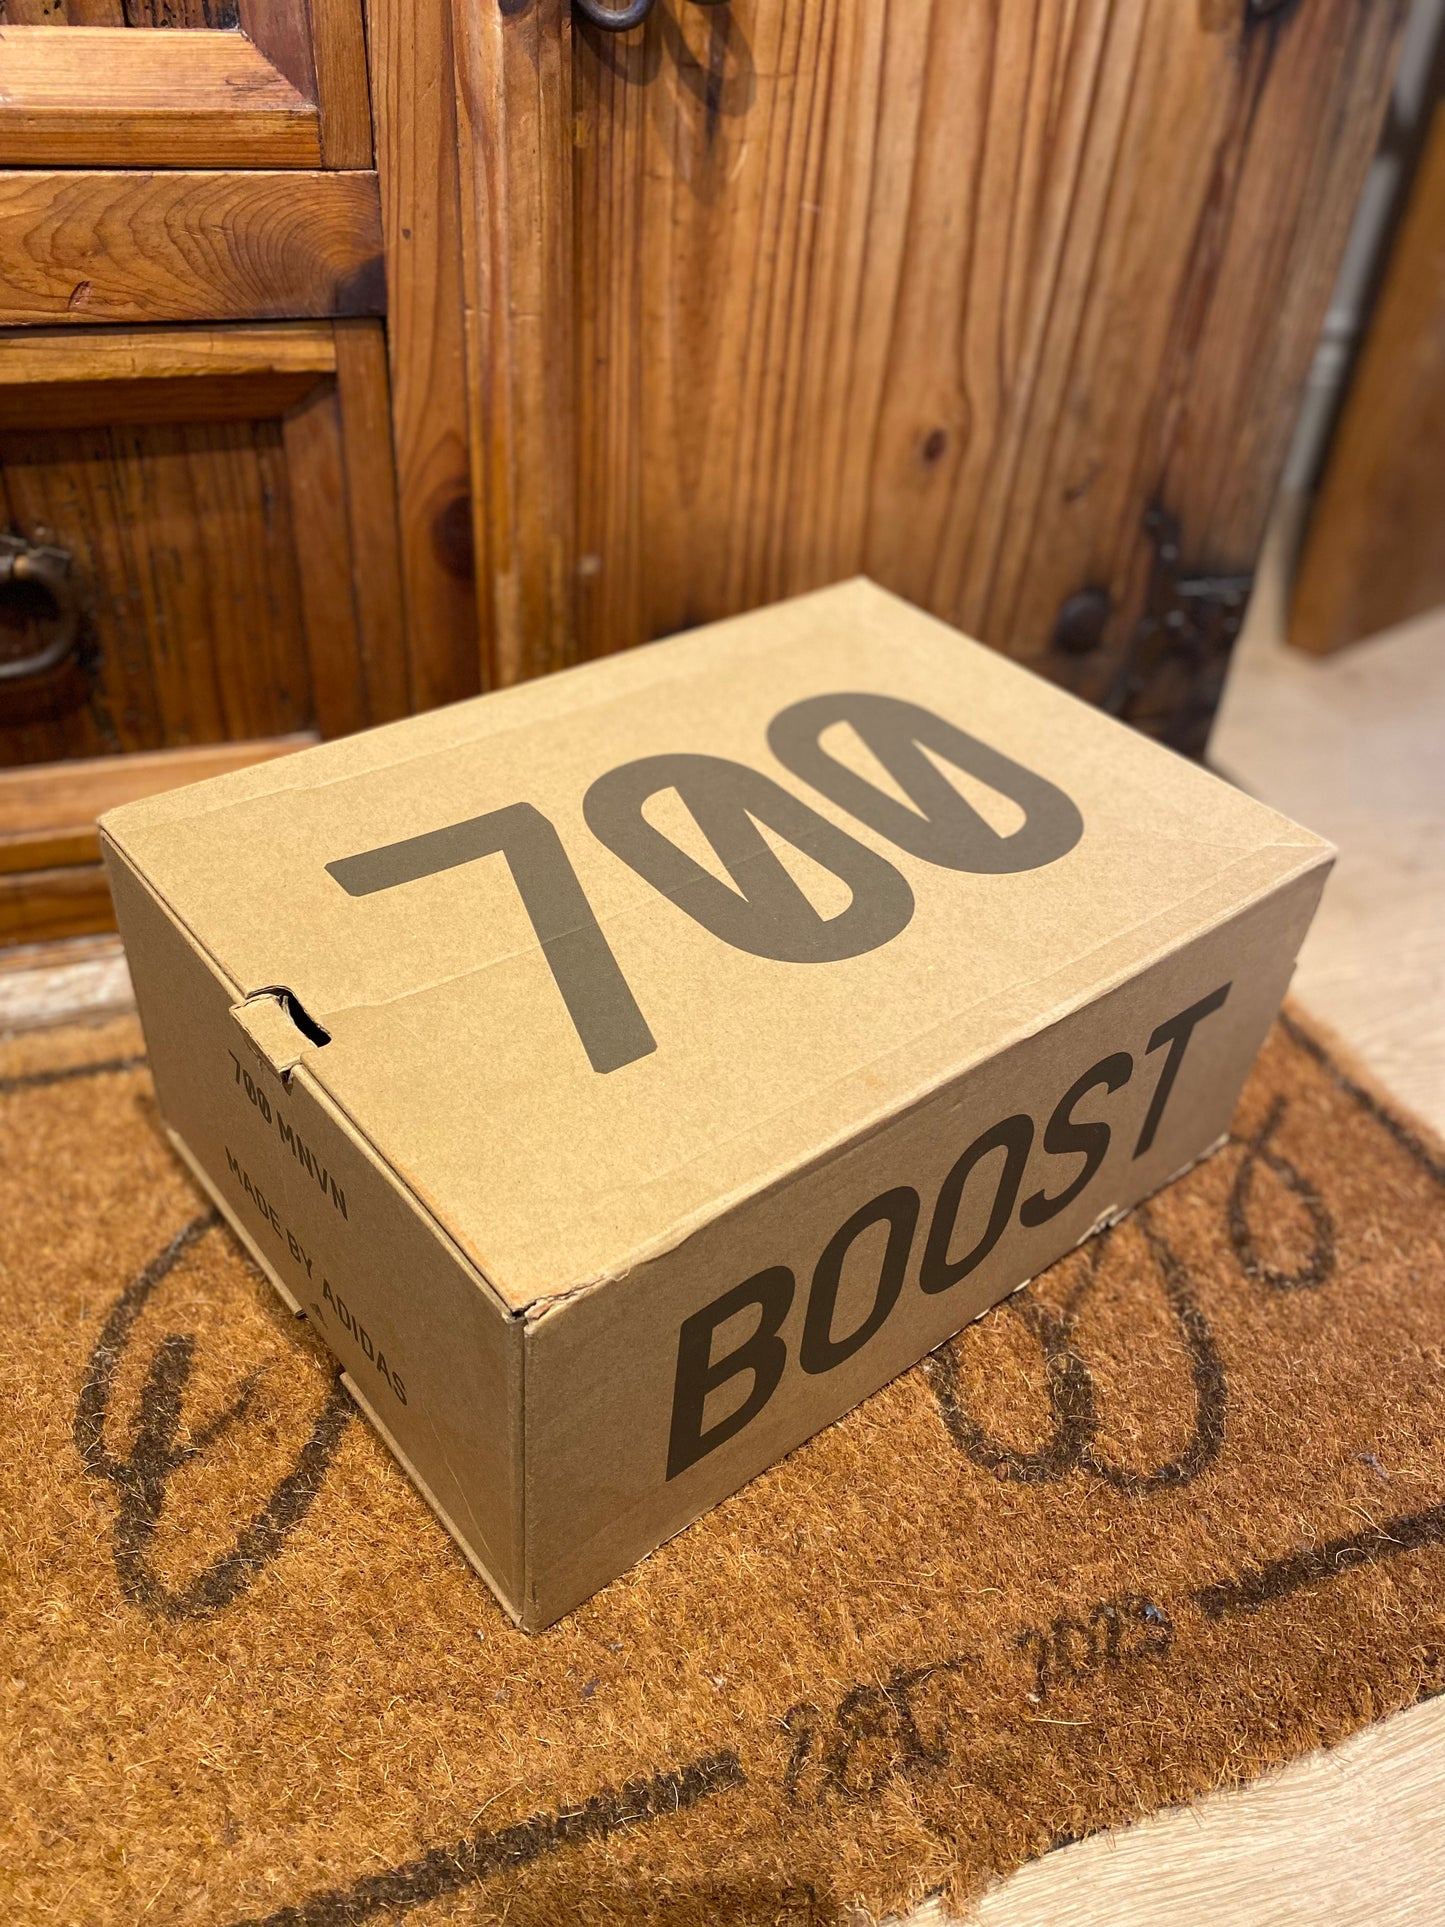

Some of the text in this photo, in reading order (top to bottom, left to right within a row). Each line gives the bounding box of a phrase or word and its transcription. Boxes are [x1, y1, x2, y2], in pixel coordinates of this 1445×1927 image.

[324, 692, 1084, 1075] 700
[224, 1145, 408, 1406] MADE BY ADIDAS
[228, 1049, 348, 1221] 700 MNVN
[666, 981, 1232, 1481] BOOST
